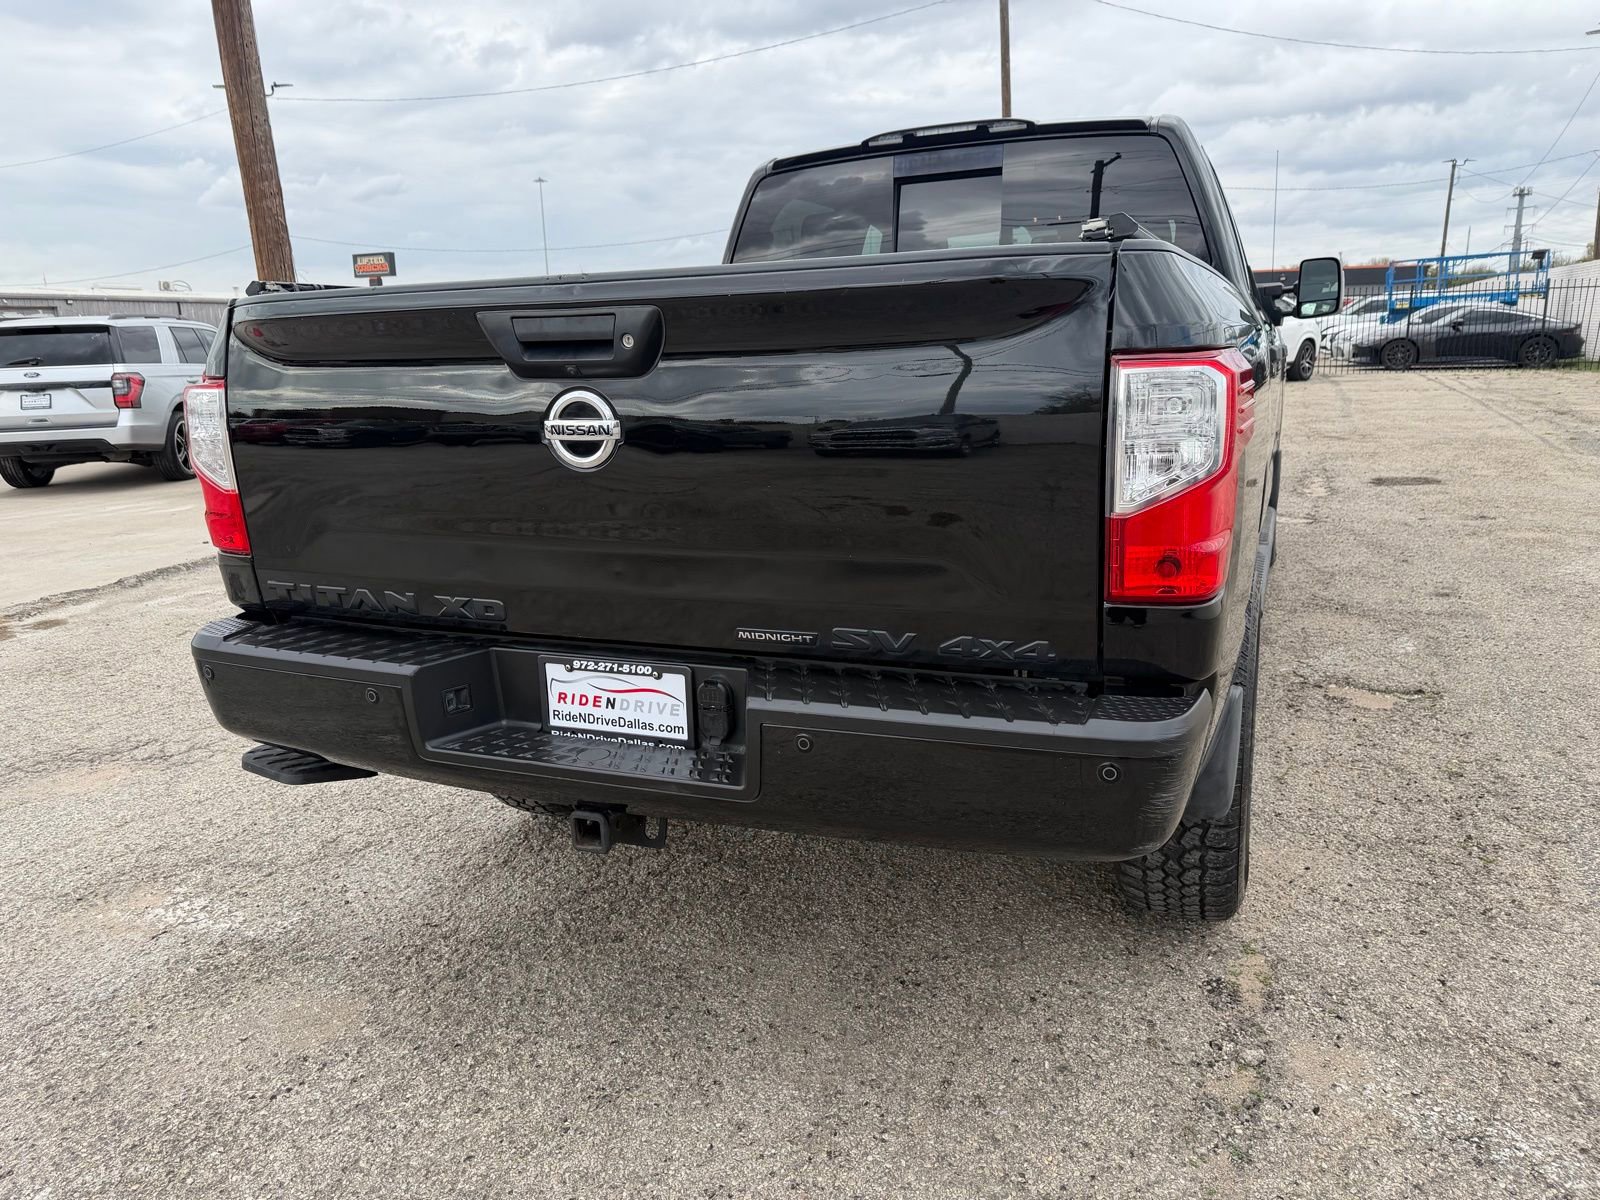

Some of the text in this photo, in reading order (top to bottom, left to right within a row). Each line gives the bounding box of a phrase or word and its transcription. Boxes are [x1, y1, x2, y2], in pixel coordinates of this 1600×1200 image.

[355, 263, 389, 273] TRUCKS
[357, 255, 385, 264] LIFTED
[550, 424, 611, 436] NISSAN
[267, 580, 507, 621] TITAN XD
[737, 630, 814, 644] MIDNIGHT
[831, 627, 917, 654] SV
[572, 660, 652, 675] 972-271-5100
[552, 709, 685, 735] RideNDriveDallas.com
[551, 730, 686, 750] RideNDriveDallascom
